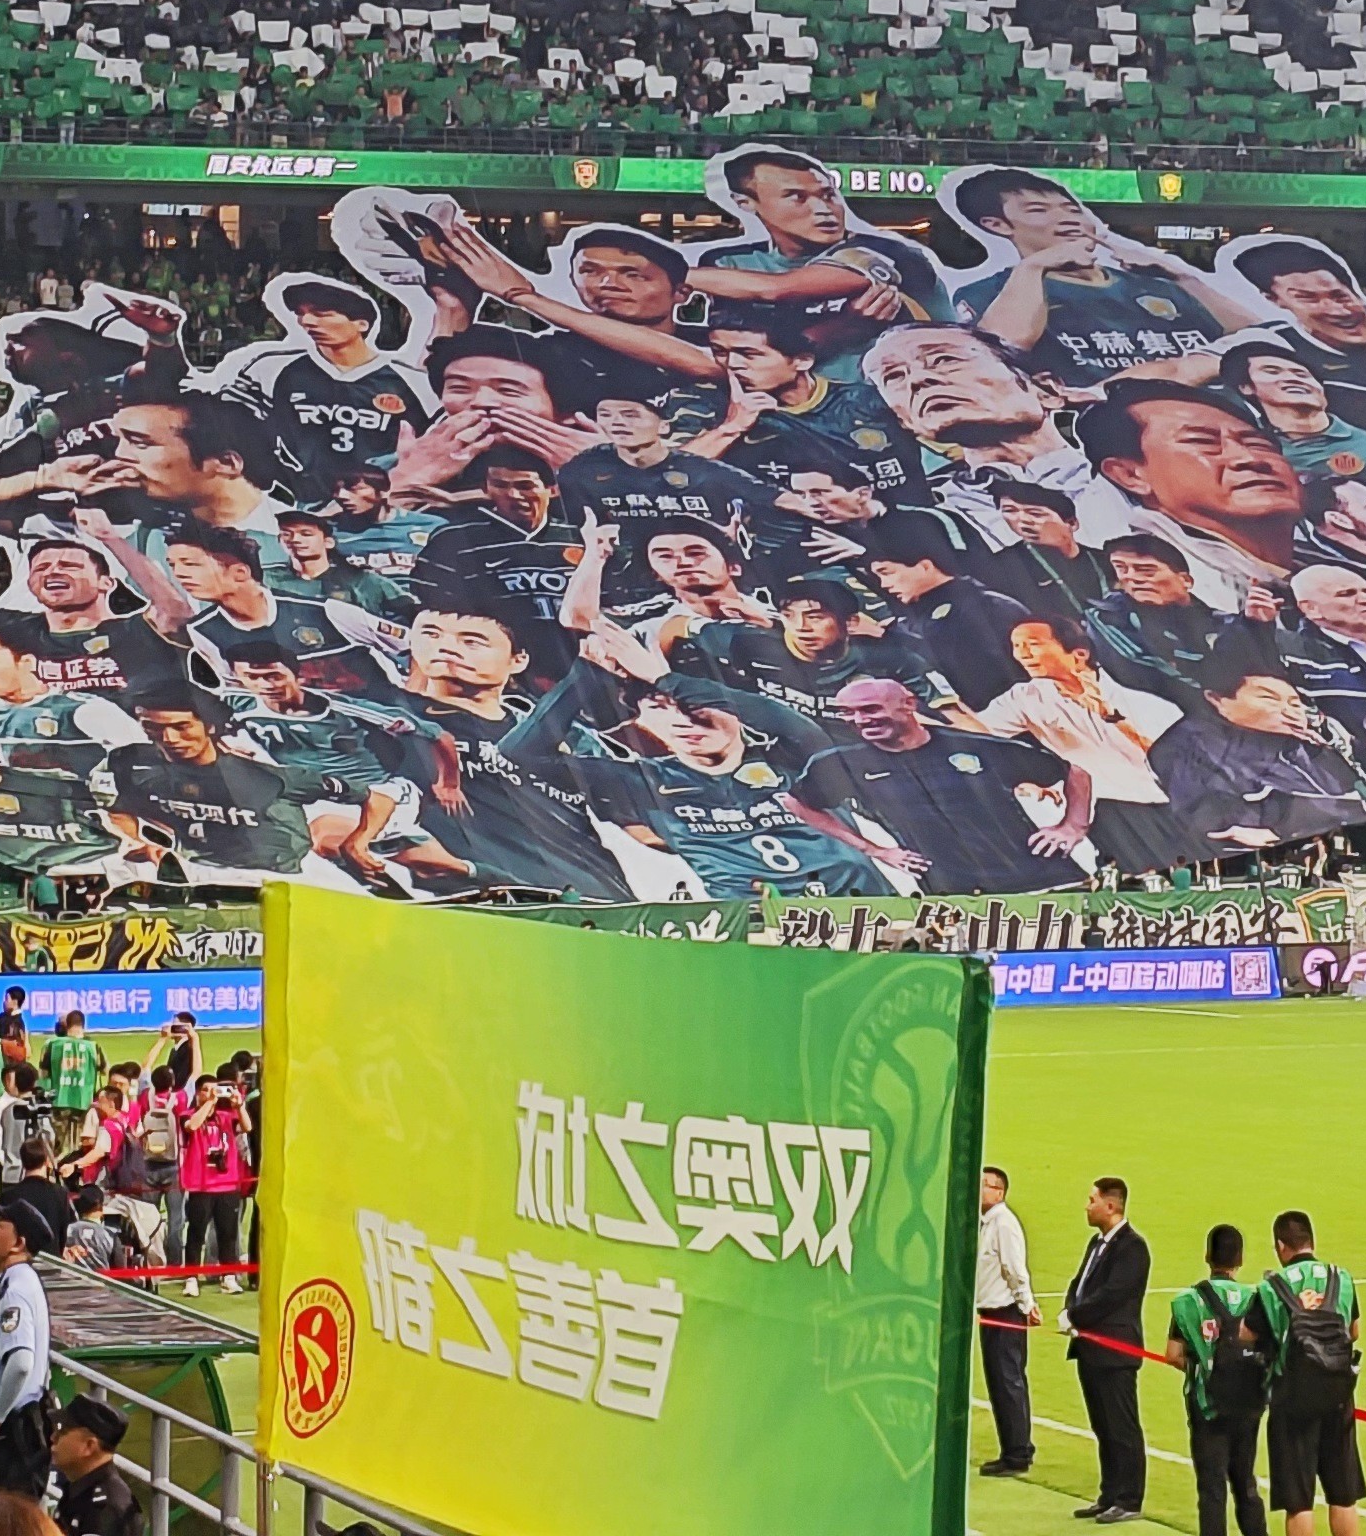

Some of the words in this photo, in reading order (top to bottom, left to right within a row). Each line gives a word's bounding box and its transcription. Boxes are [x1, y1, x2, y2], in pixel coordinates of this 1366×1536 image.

[206, 154, 358, 177] 国安永远争第一
[850, 170, 881, 192] BE
[890, 171, 933, 194] NO.
[294, 404, 392, 432] RYOBI
[331, 427, 354, 452] 3
[760, 813, 807, 827] GROU
[750, 834, 801, 874] 8
[30, 990, 152, 1018] 国建设银行
